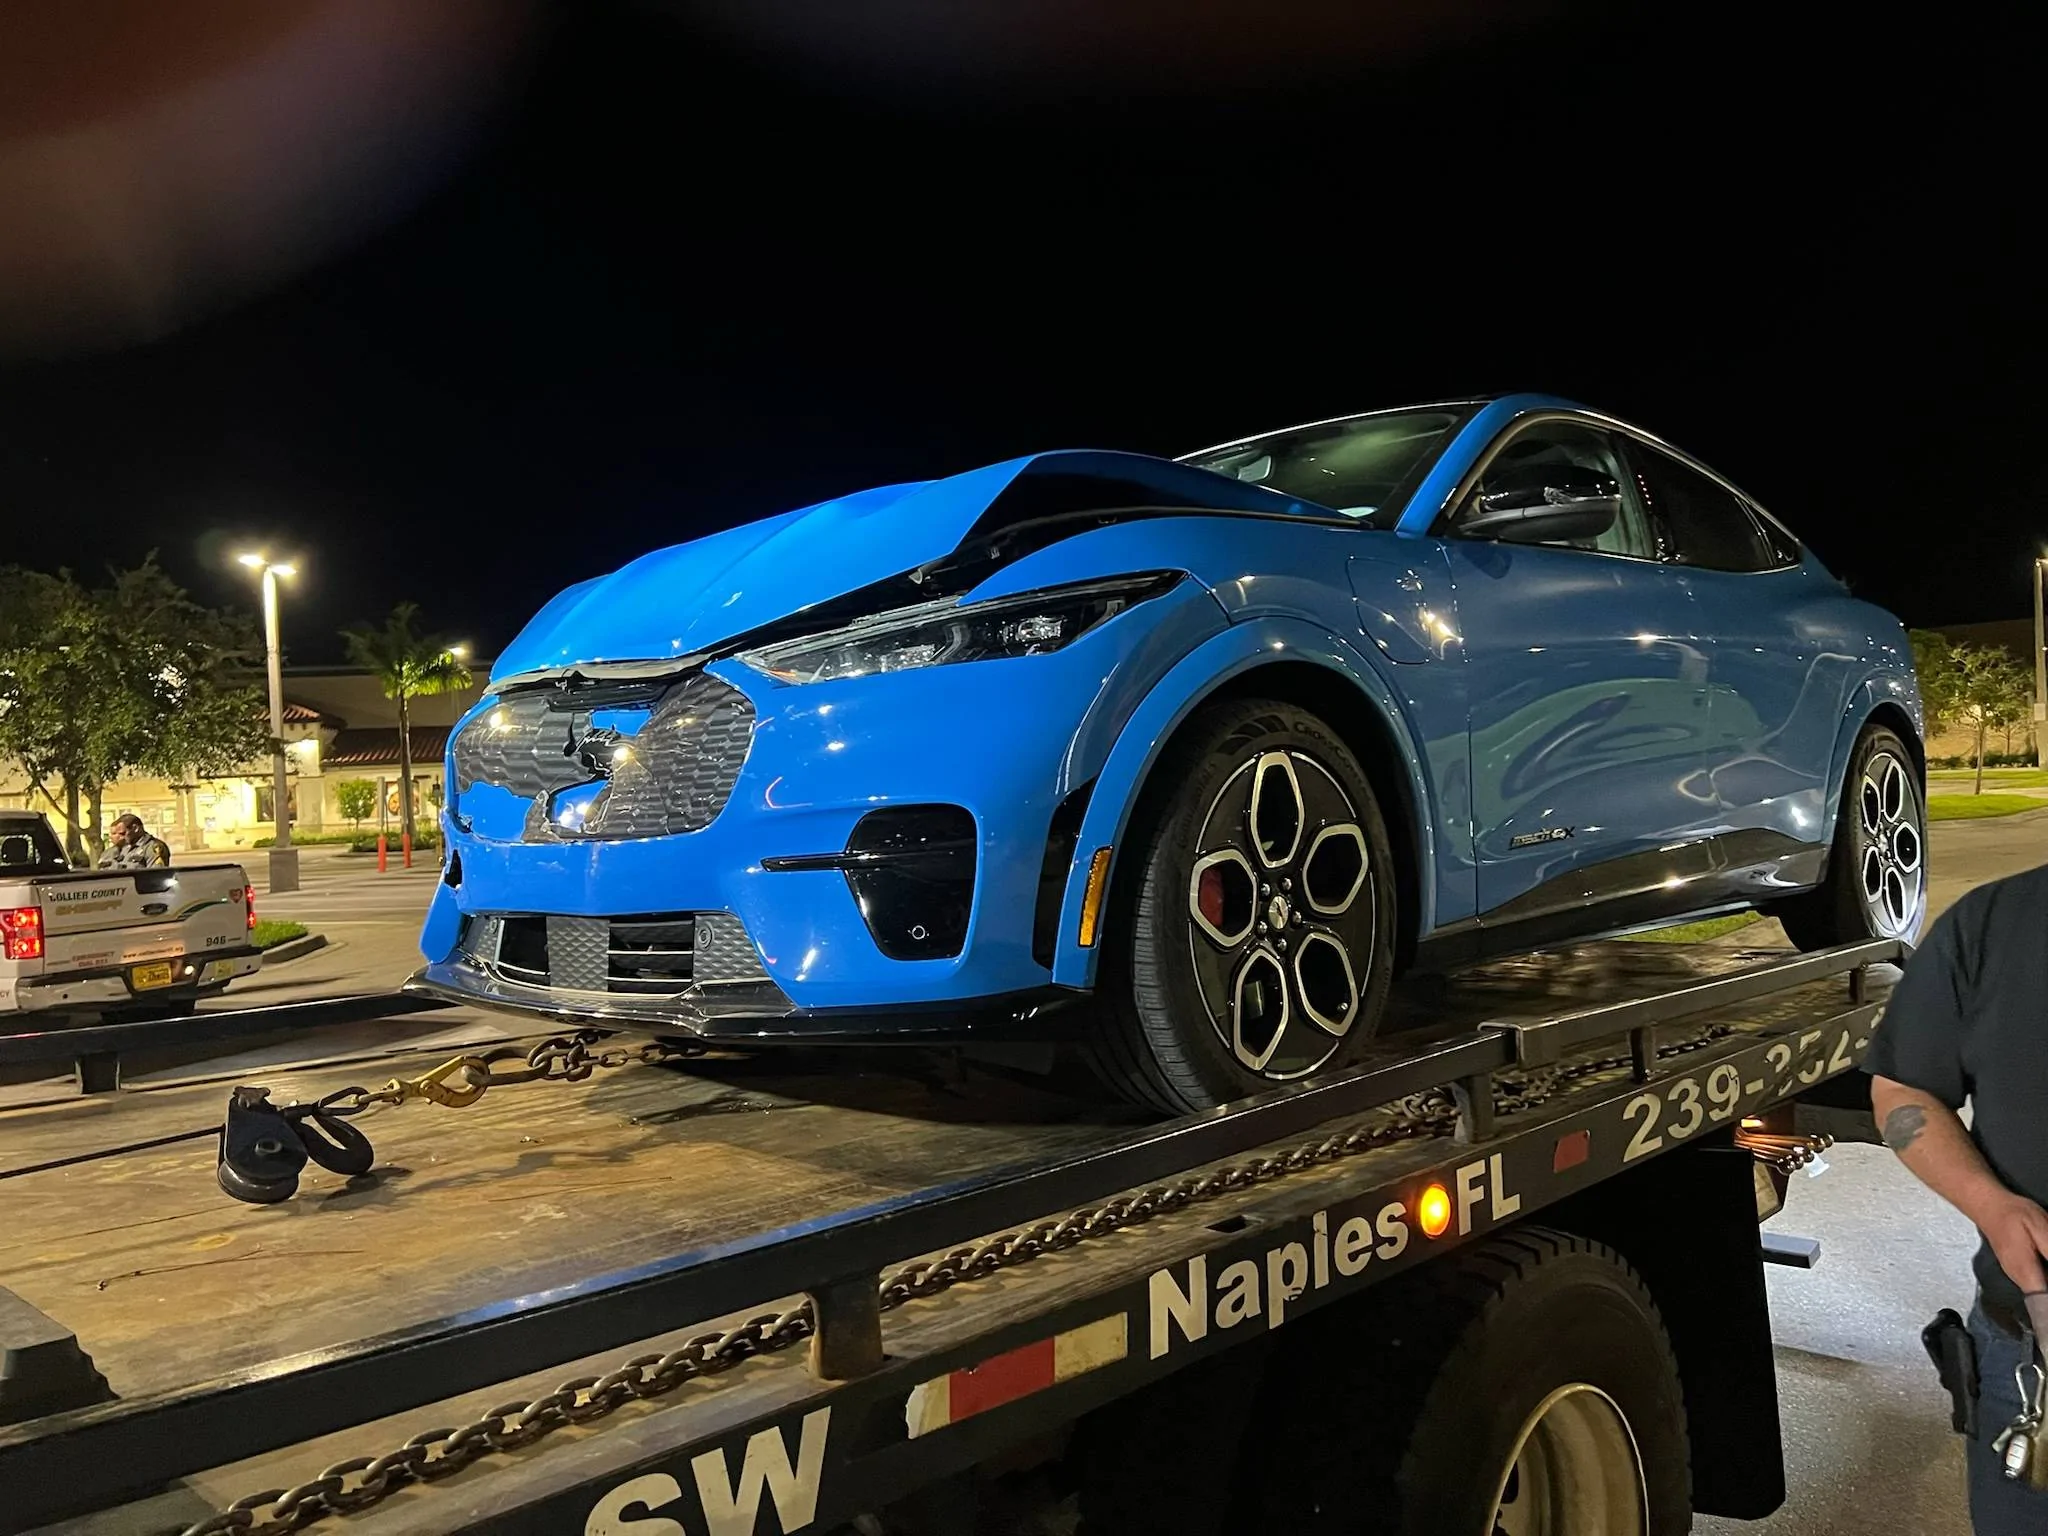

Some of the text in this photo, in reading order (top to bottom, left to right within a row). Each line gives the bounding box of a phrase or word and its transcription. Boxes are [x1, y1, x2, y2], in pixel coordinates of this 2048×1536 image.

[91, 887, 127, 899] COUNTY
[1149, 1152, 1521, 1360] Naples FL
[584, 1405, 832, 1536] SW
